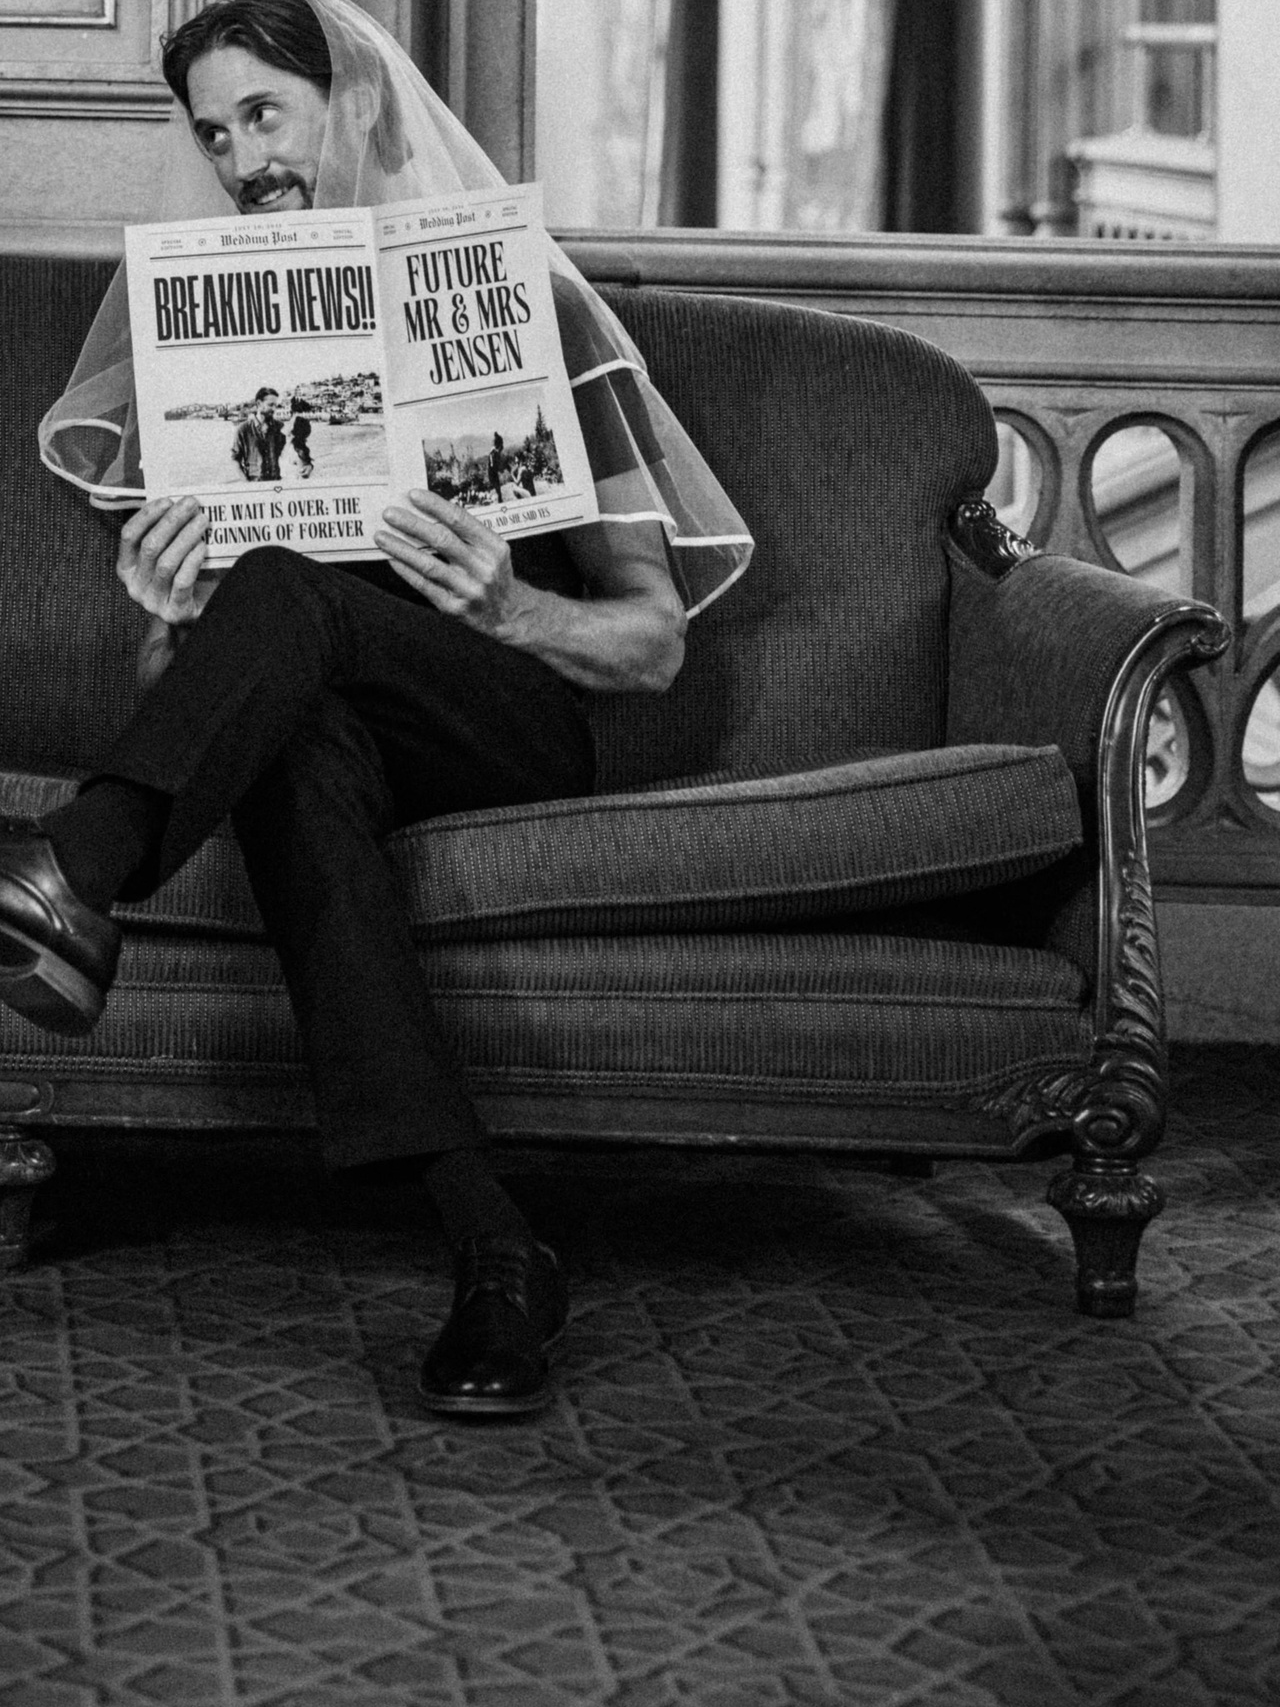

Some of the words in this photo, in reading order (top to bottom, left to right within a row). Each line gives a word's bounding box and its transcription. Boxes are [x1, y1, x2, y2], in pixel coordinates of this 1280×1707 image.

[220, 234, 269, 247] Wedding
[271, 231, 297, 245] Post
[456, 212, 476, 226] Post
[406, 241, 508, 297] FUTURE
[153, 269, 282, 341] BREAKING
[286, 265, 377, 334] NEWS!!
[403, 297, 444, 343] MR
[451, 293, 470, 334] &
[475, 282, 531, 331] MRS
[430, 329, 523, 385] JENSEN
[231, 502, 266, 521] WAIT
[270, 501, 284, 519] IS
[288, 498, 329, 518] OVER:
[333, 497, 362, 515] THE
[201, 525, 271, 545] EGINNING
[275, 523, 294, 541] OF
[299, 520, 364, 540] FOREVER
